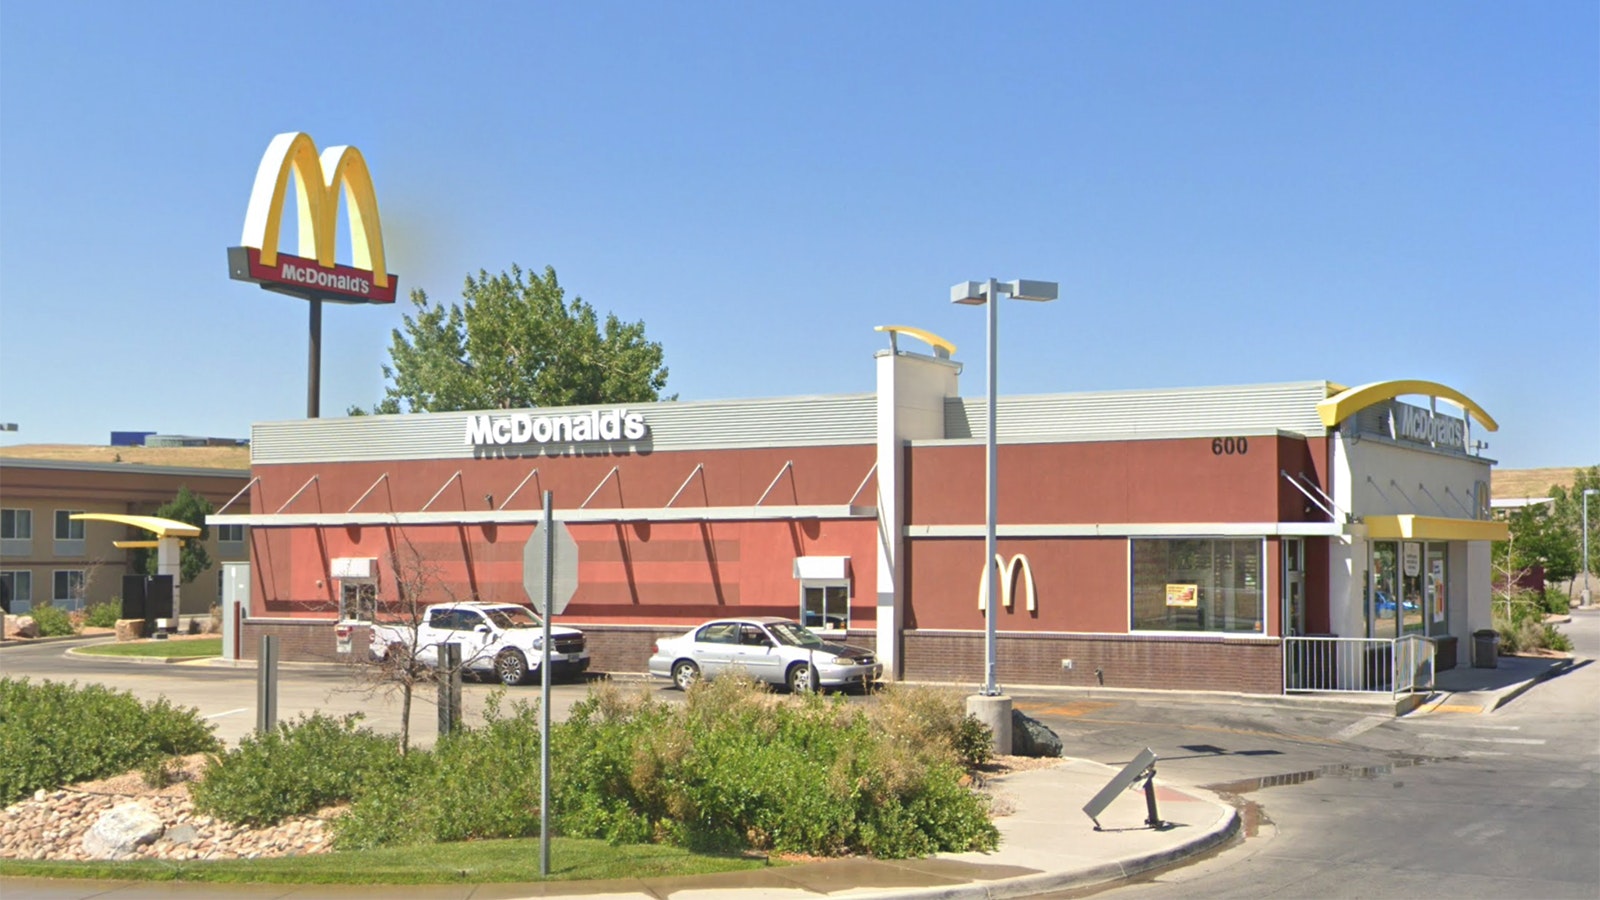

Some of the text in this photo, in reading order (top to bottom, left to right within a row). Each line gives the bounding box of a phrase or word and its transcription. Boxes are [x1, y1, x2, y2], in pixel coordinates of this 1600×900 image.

[281, 263, 370, 294] McDonald's
[464, 408, 647, 446] McDonald's
[1211, 436, 1248, 456] 600
